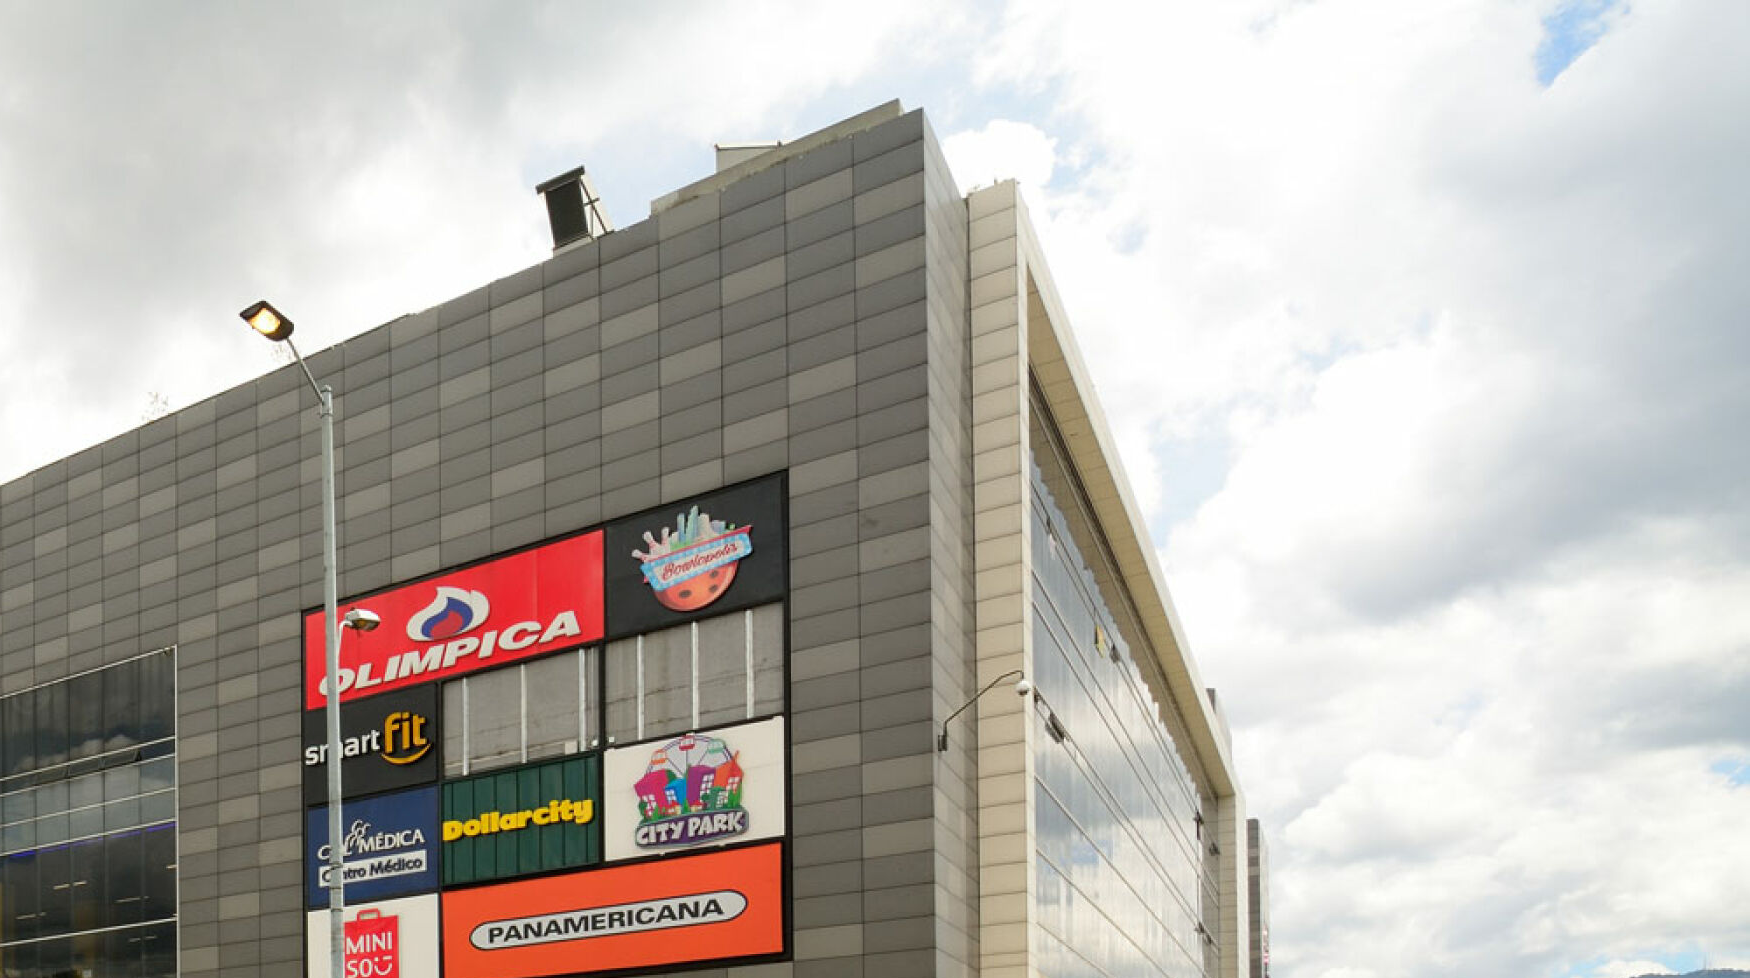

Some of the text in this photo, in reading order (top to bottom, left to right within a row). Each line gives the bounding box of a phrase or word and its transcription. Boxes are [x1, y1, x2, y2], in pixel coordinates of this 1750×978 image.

[319, 610, 581, 695] OLIMPICA
[384, 711, 427, 754] fit
[443, 798, 594, 841] Dollarcity
[637, 811, 743, 845] CITY PARK
[317, 828, 426, 860] CLMÉDICA
[322, 856, 423, 883] Cntro Médico
[488, 899, 724, 944] PANAMERICANA
[346, 931, 392, 955] MINI
